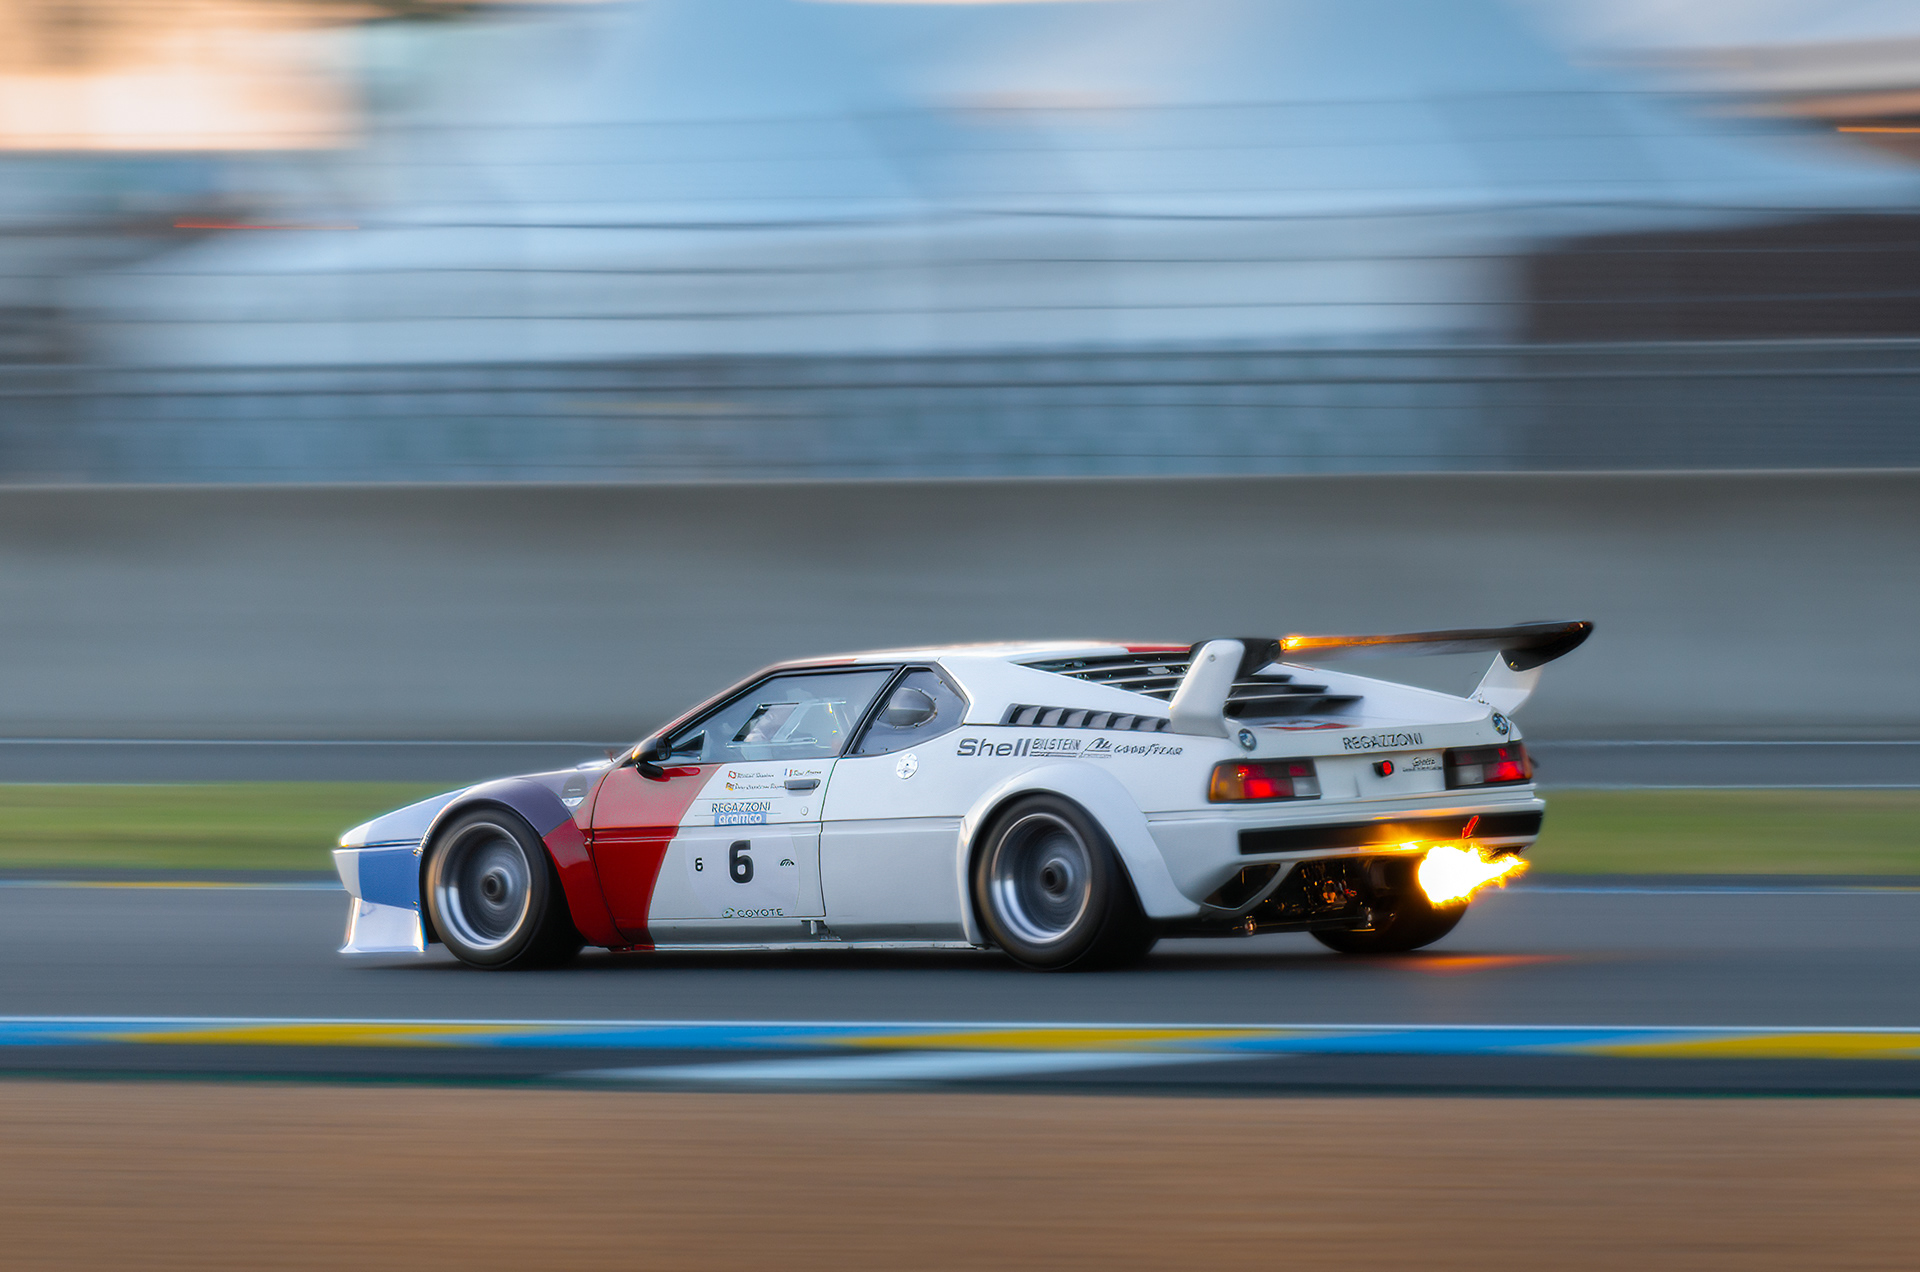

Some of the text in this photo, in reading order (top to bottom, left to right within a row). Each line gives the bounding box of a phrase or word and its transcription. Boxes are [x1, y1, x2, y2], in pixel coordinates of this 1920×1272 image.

[956, 737, 1032, 757] Shell
[1031, 738, 1082, 751] BILSTEIN
[1342, 732, 1424, 750] REGAZZONI
[711, 801, 771, 813] REGAZZONI
[718, 813, 763, 825] aramco
[694, 857, 704, 872] 6
[728, 839, 754, 884] 6
[736, 908, 784, 918] COYOTE
